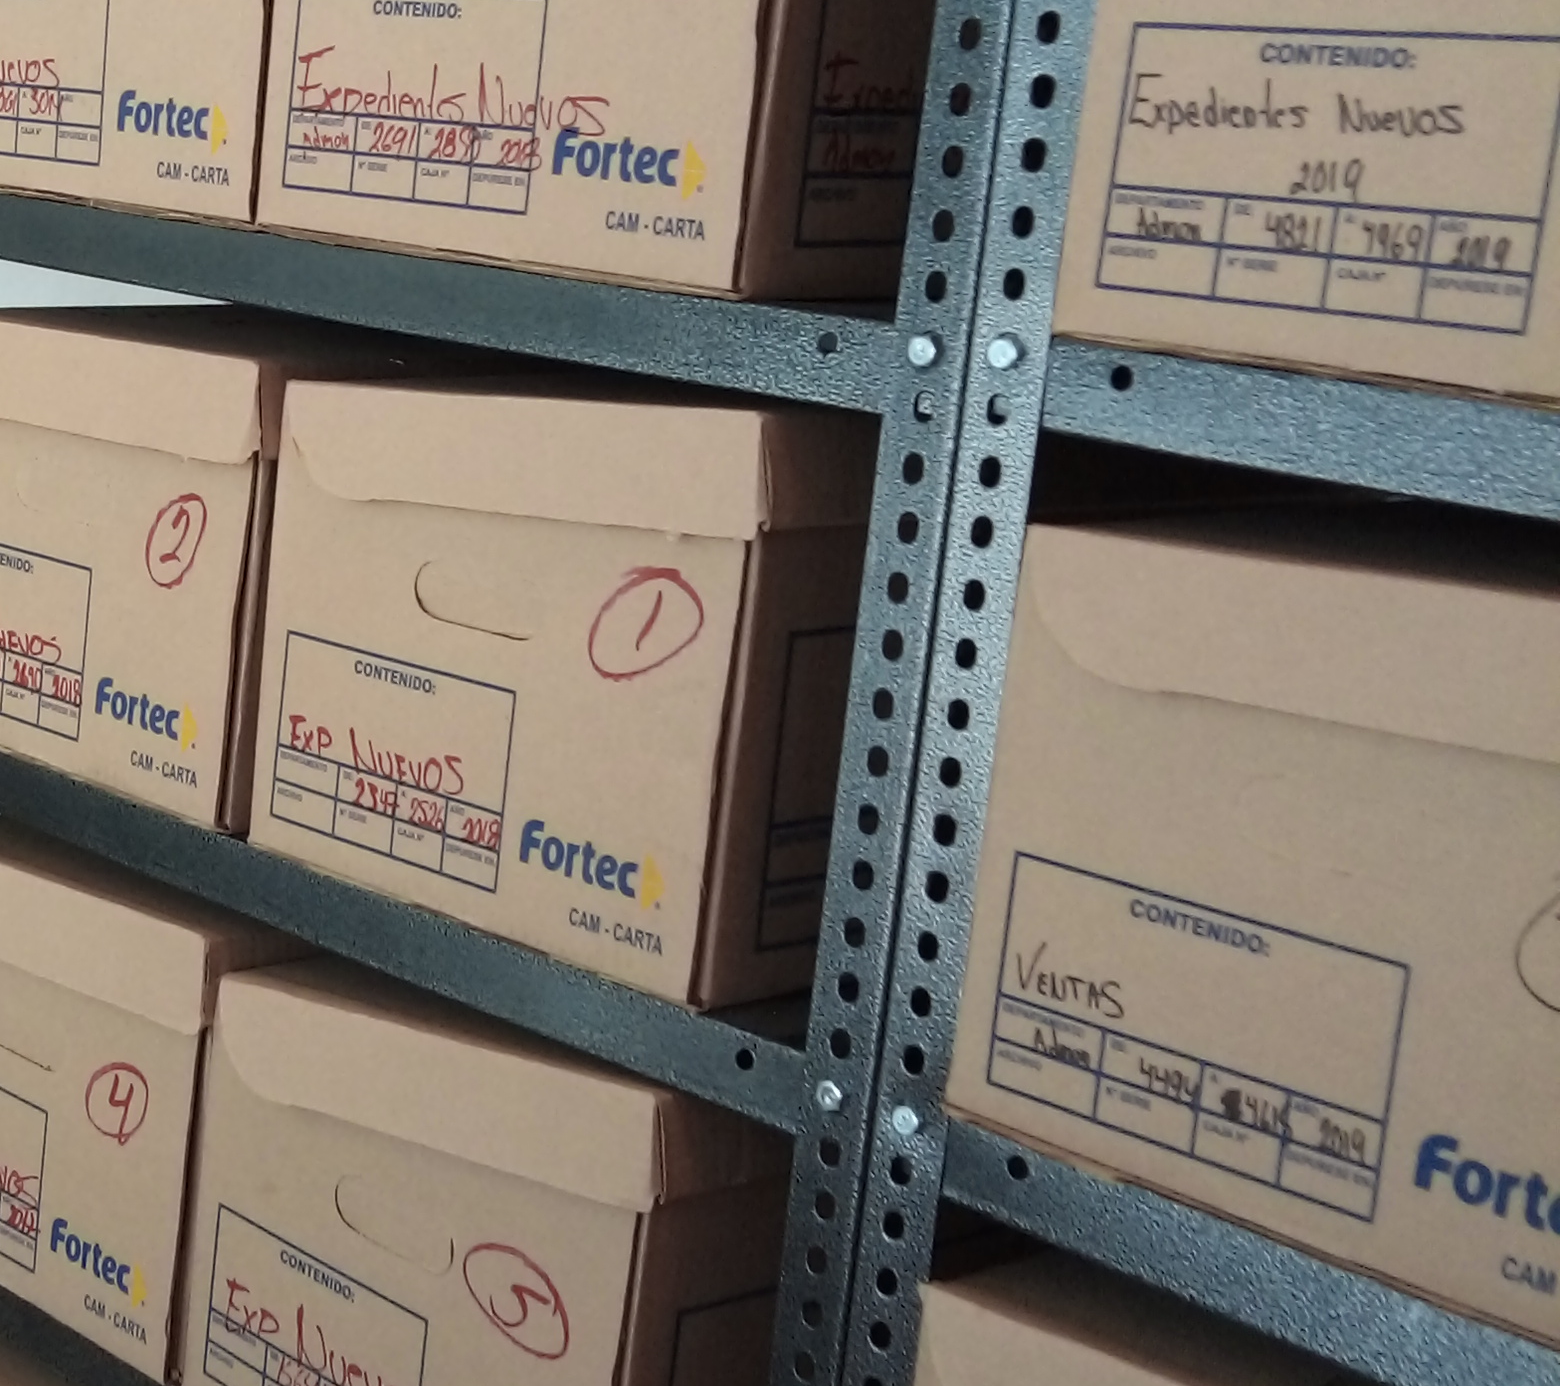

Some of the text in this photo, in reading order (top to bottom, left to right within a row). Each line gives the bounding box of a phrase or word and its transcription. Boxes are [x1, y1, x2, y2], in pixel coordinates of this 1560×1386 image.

[373, 0, 463, 20] CONTENIDO:
[1260, 43, 1416, 70] CONTENIDO:
[117, 89, 210, 140] Fortec
[369, 121, 417, 155] 2691
[157, 162, 230, 187] CAM CARTA
[552, 126, 679, 188] Fortec
[1289, 158, 1368, 203] 2019
[605, 211, 706, 241] CAM CARTA
[354, 660, 436, 695] CONTENIDO:
[95, 677, 179, 741] Fortec
[130, 749, 197, 788] CAM CARTA
[519, 819, 639, 900] Fortec
[568, 907, 664, 956] CAM CARTA
[1129, 898, 1271, 957] CONTENIDO:
[50, 1218, 131, 1295] Fortec
[280, 1250, 356, 1303] CONTENIDO:
[1500, 1255, 1558, 1297] CAM
[84, 1294, 147, 1345] CAM CARTA
